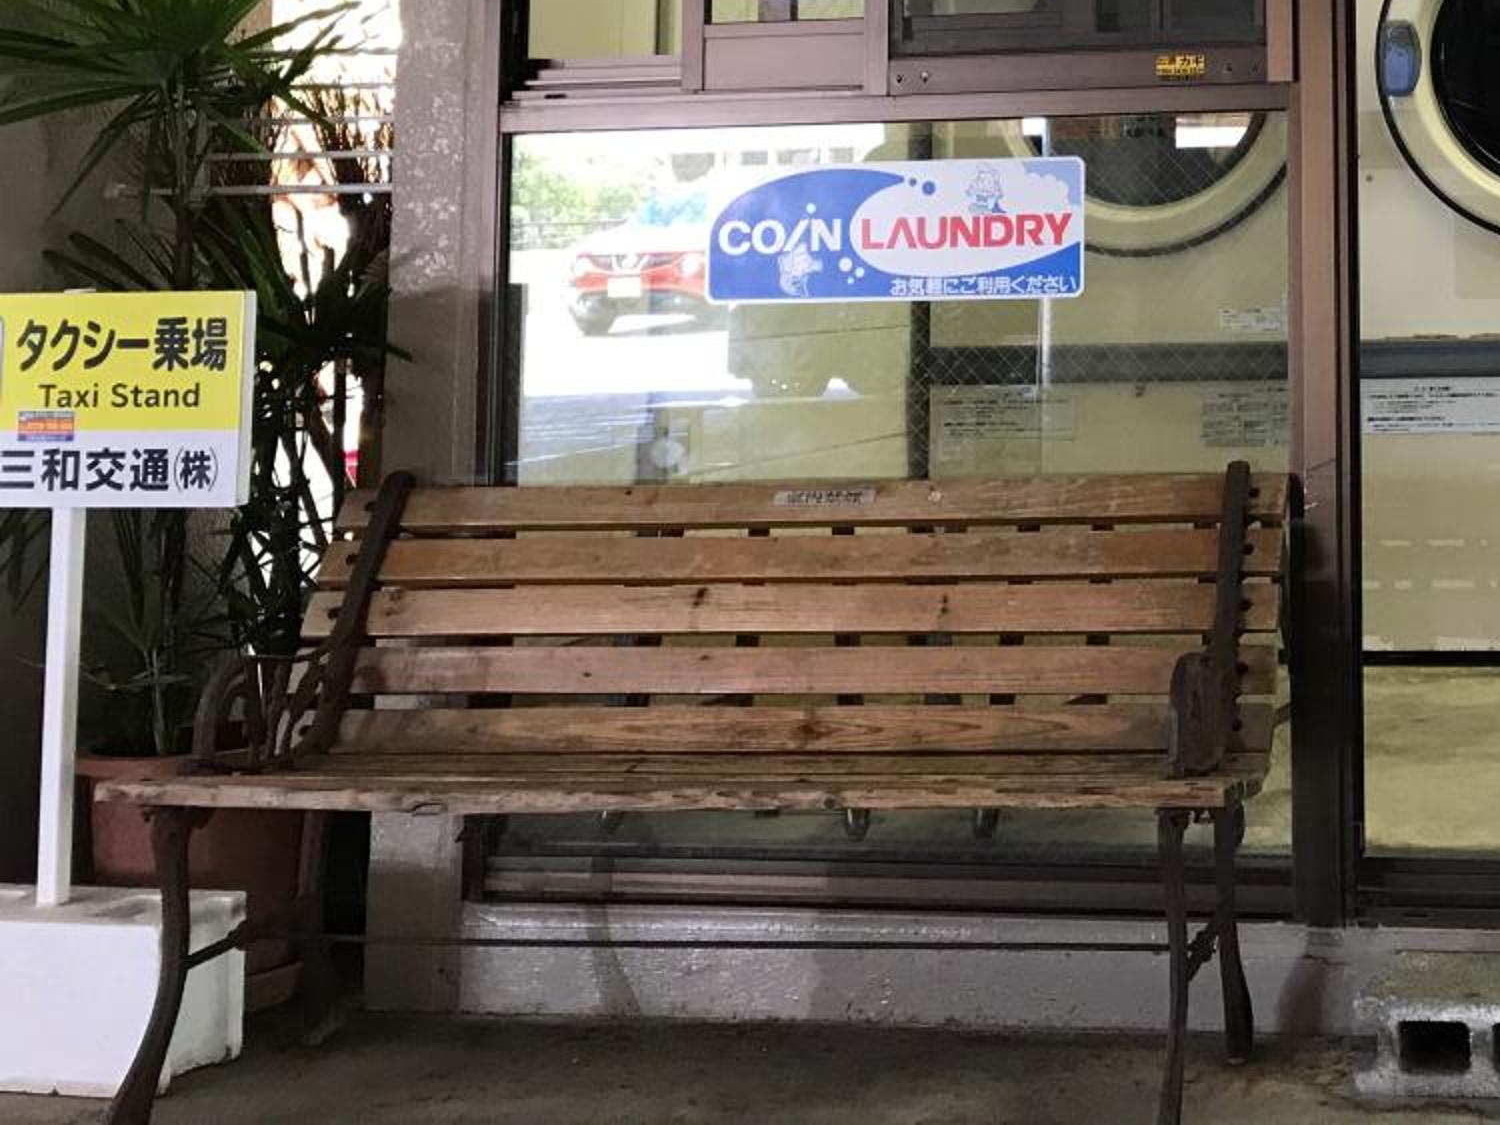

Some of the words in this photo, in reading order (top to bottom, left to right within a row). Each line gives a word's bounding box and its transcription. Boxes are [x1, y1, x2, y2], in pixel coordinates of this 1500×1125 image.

[861, 212, 1073, 250] LAUNDRY
[889, 275, 1077, 297] お気軽にご利用ください
[16, 316, 229, 372] タクシー乗場
[38, 383, 99, 409] Taxi
[111, 382, 200, 409] Stand
